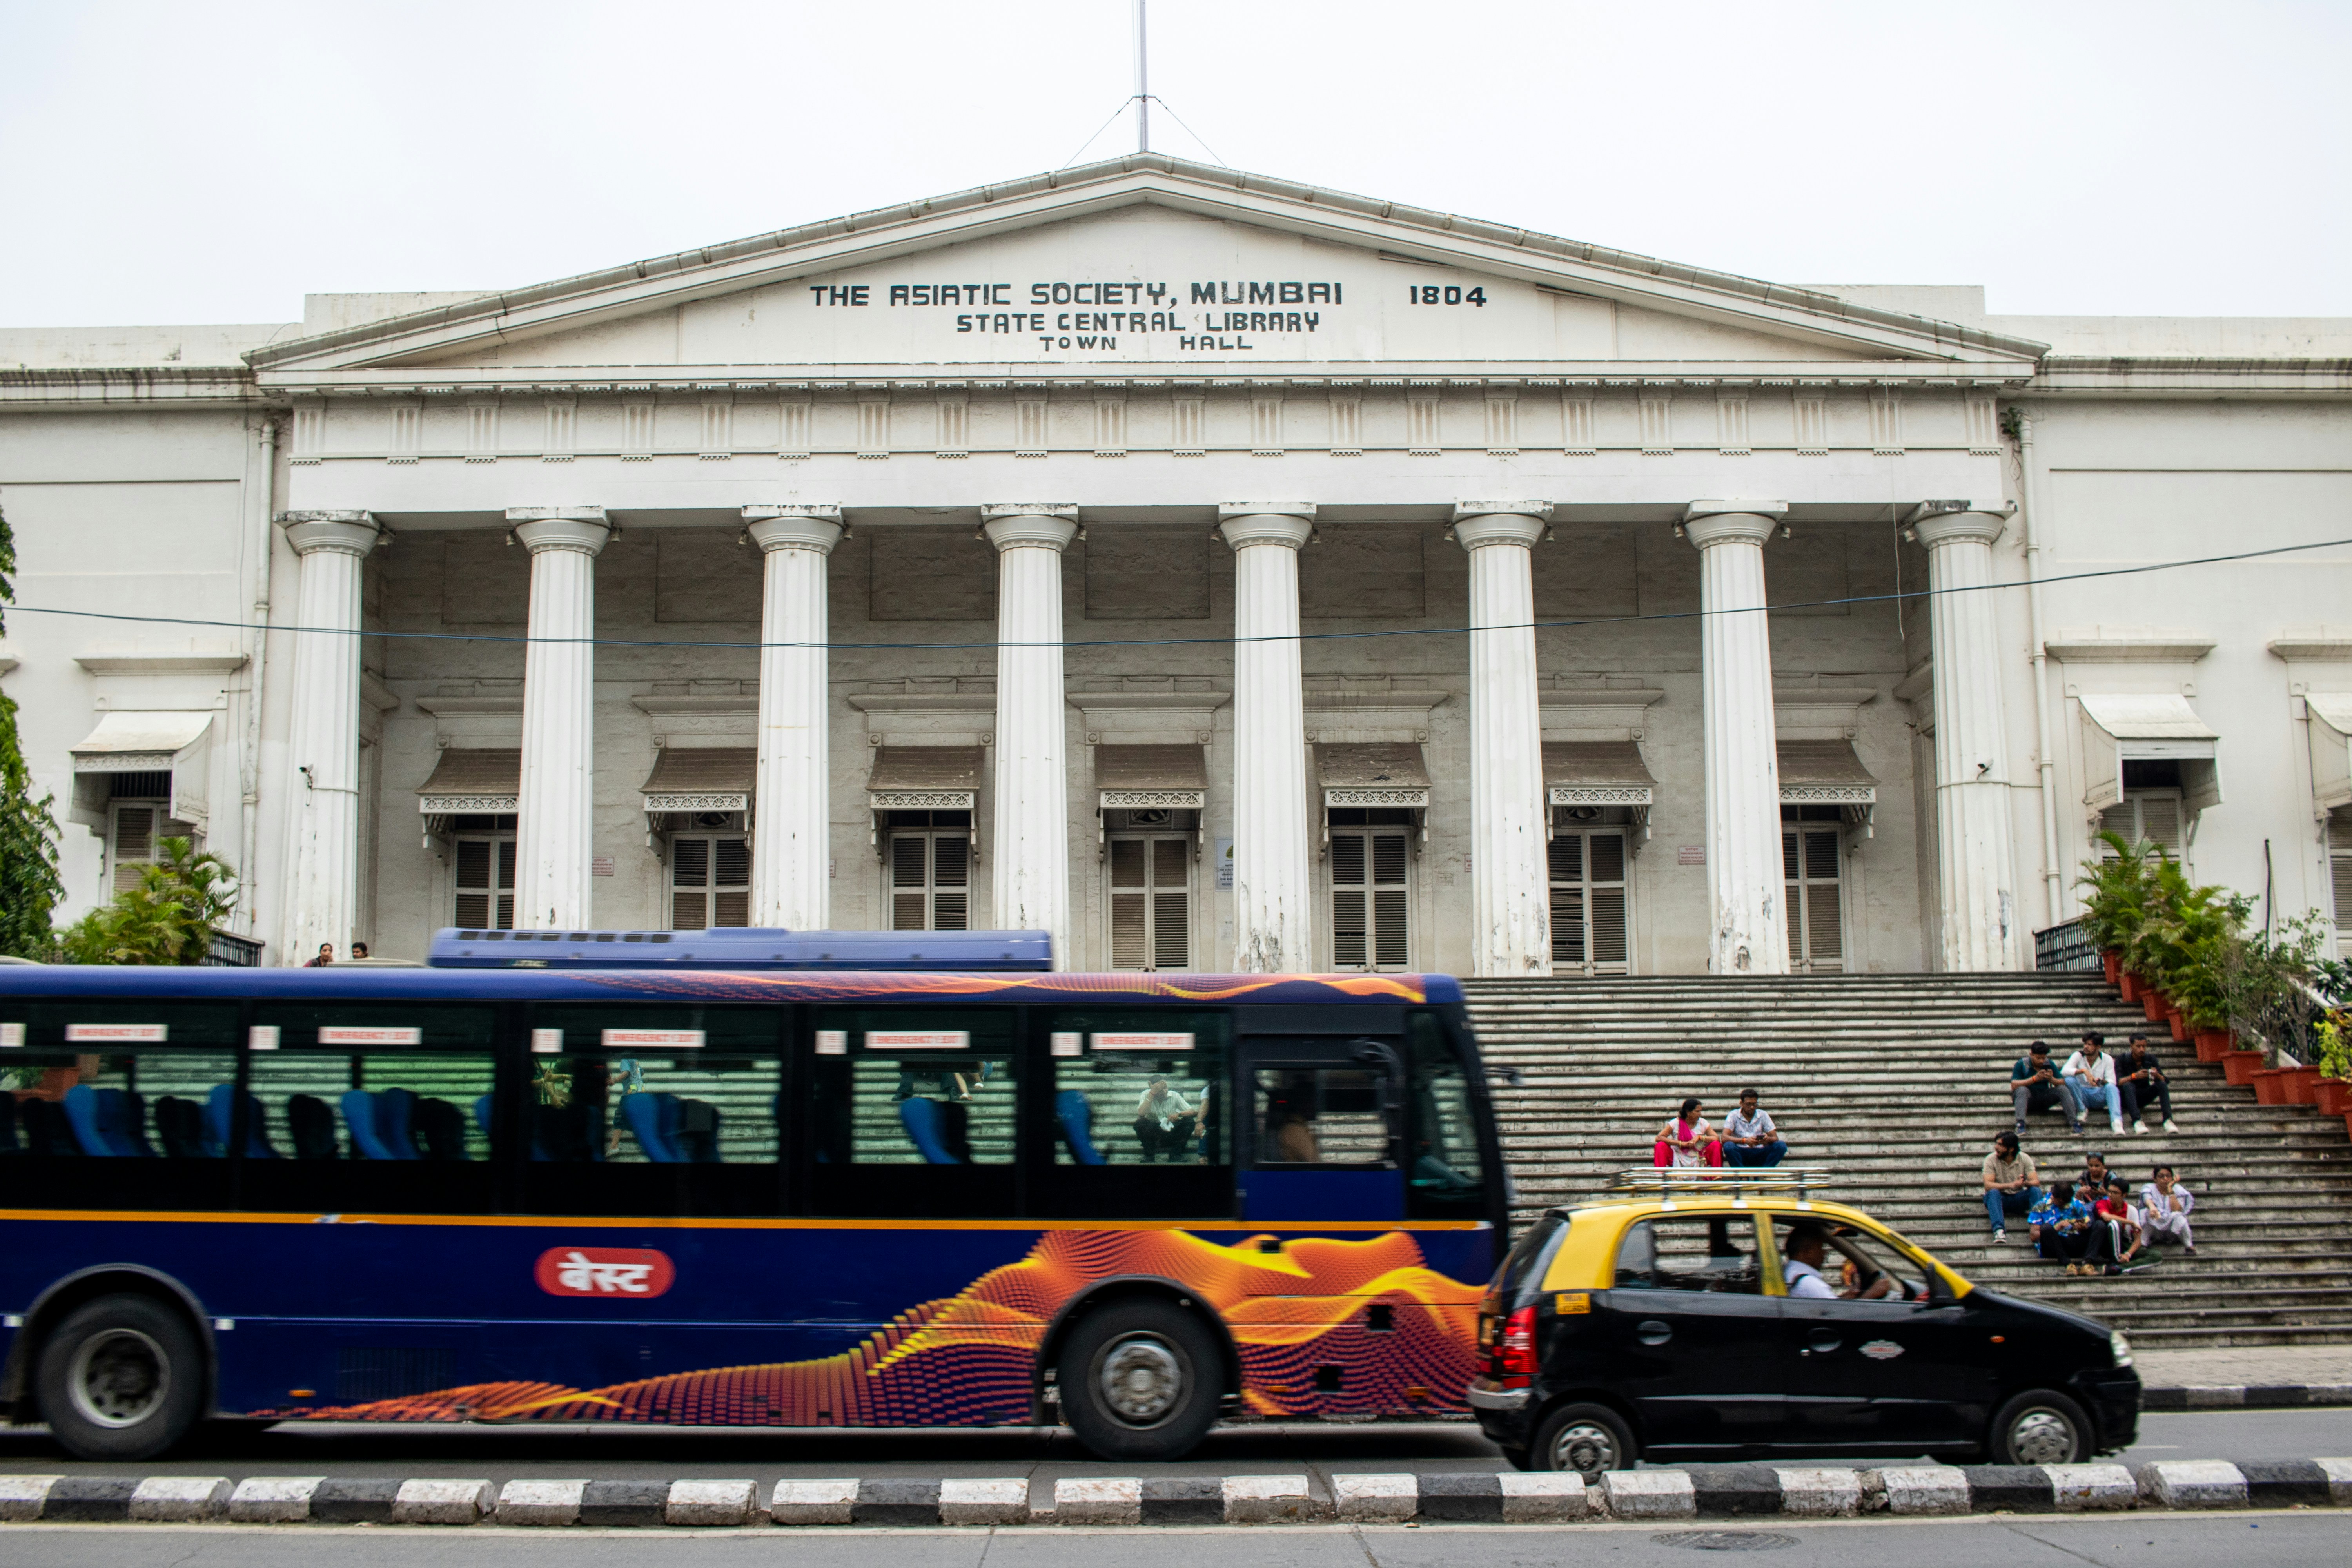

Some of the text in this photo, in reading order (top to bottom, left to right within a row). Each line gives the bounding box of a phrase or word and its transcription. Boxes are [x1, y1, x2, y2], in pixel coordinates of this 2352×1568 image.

[809, 281, 1342, 309] THE ASIATIC SOCIETY, MUMBAI
[1410, 285, 1487, 307] 1804
[957, 312, 1319, 334] STATE CENTRAL LIBRARY
[1039, 335, 1253, 352] TOWN HALL
